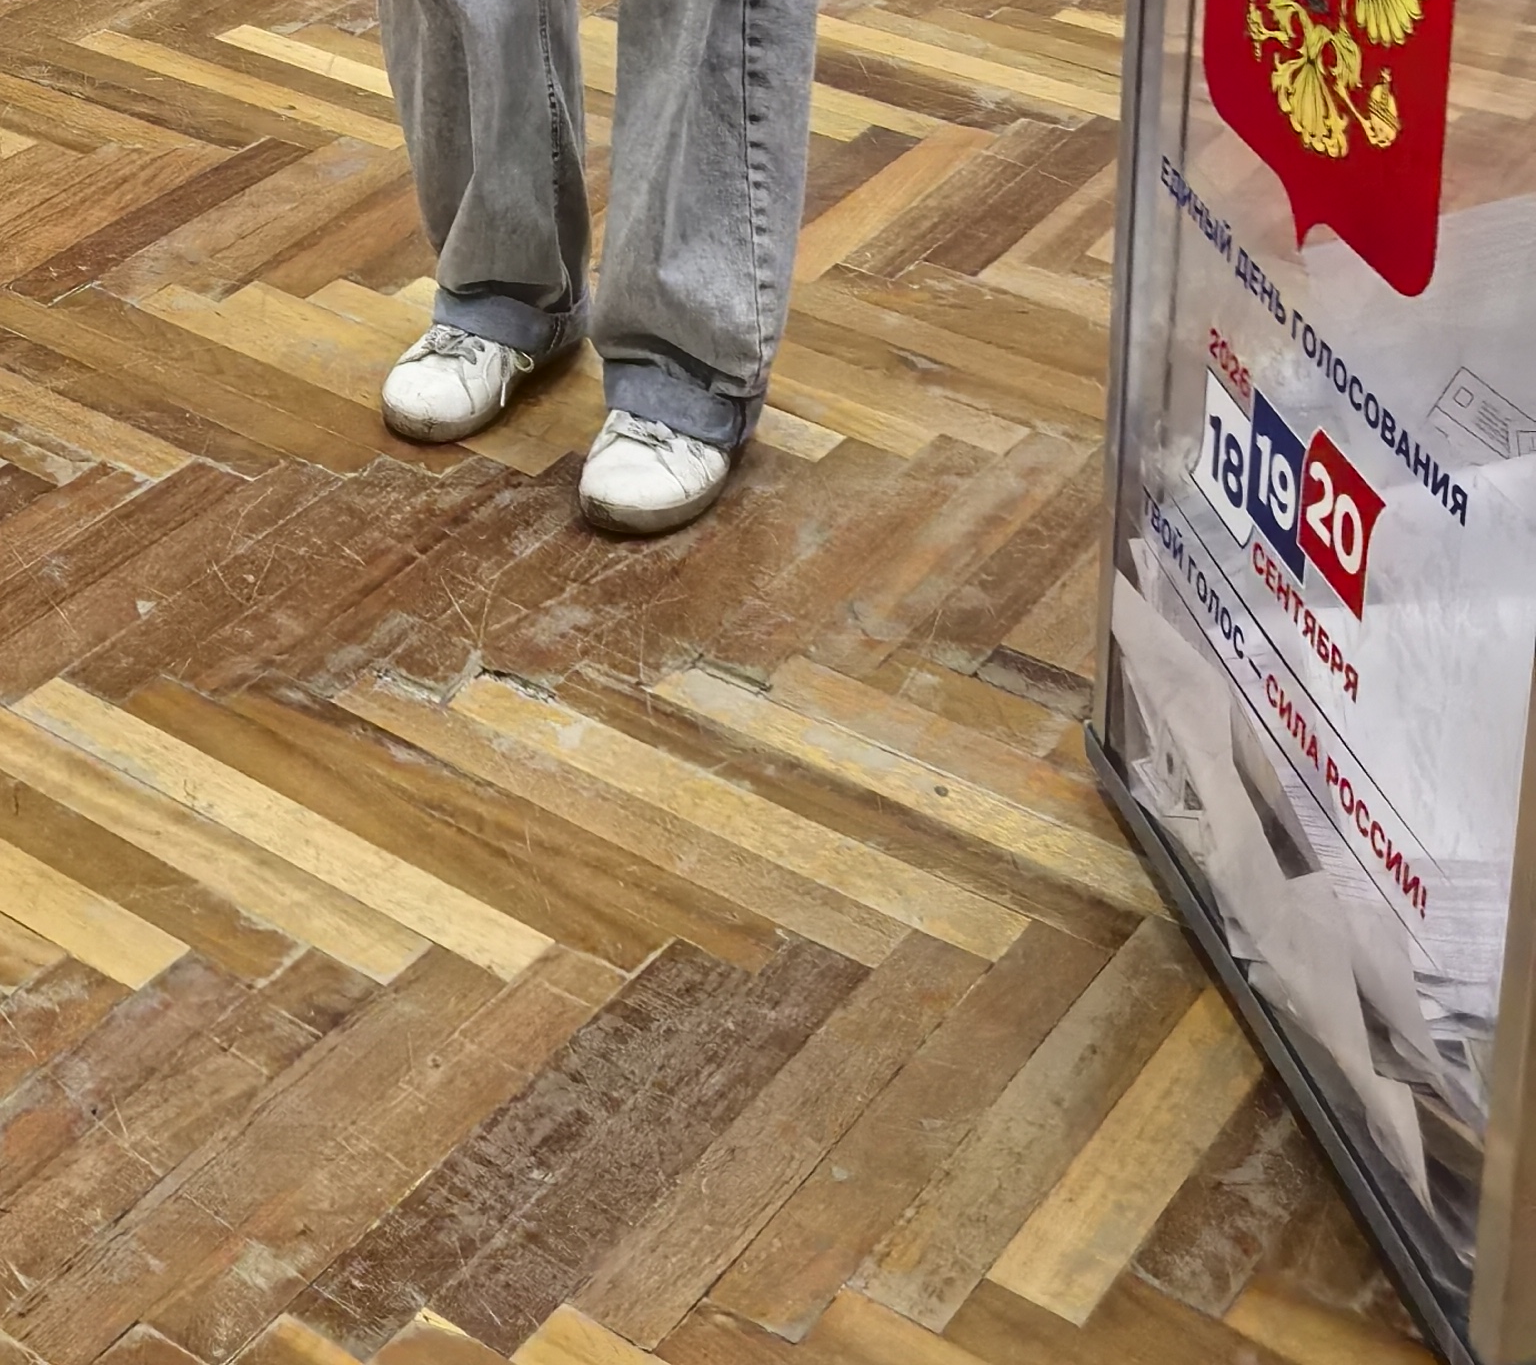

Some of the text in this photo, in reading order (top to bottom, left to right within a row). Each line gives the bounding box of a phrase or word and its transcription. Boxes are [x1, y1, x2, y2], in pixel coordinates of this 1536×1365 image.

[1161, 155, 1468, 527] ЕДИНЫЙ ДЕНЬ ГОЛОСОВАНИЯ
[1209, 414, 1364, 575] 18 19 20
[1252, 542, 1359, 703] СЕНТЯБРЯ
[1143, 485, 1184, 570] ТВОЙ
[1187, 555, 1245, 660] ГОЛОС
[1265, 673, 1319, 772] СИЛА
[1325, 754, 1427, 920] РОССИИ!
